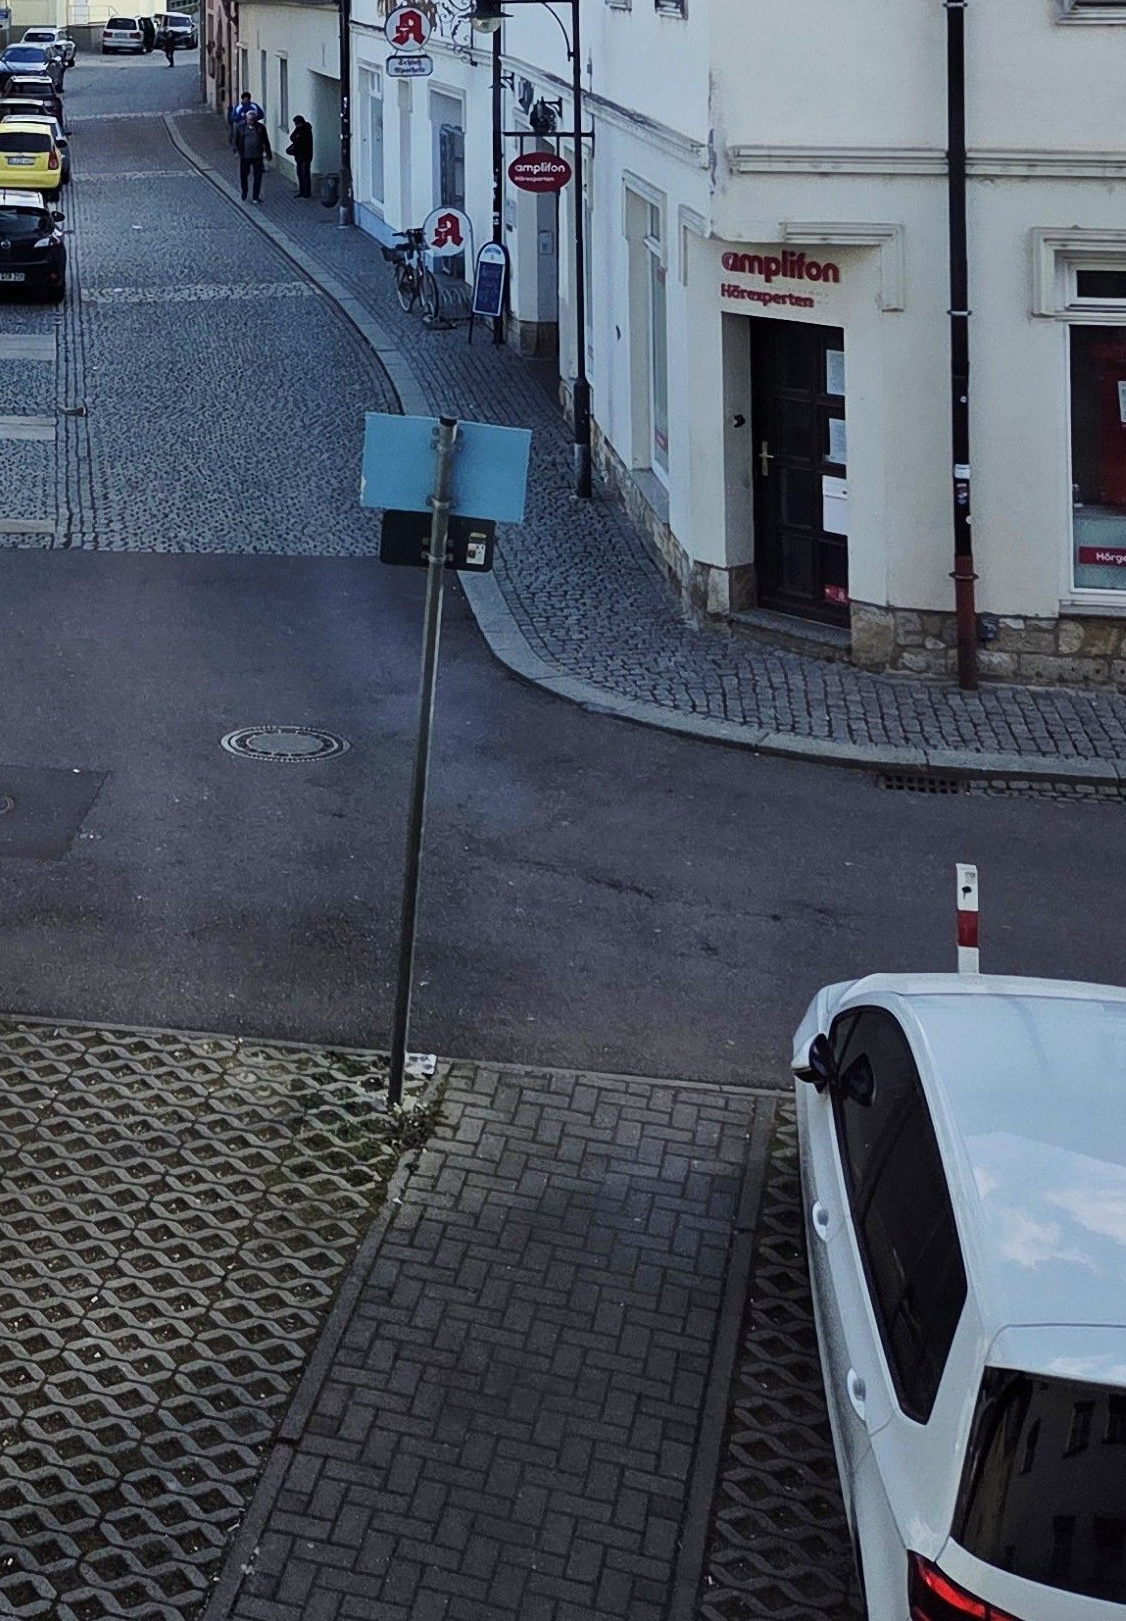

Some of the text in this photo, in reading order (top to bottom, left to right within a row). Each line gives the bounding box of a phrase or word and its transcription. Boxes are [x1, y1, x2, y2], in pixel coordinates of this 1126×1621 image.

[515, 162, 566, 175] amplifon
[721, 250, 840, 283] amplifon
[720, 283, 814, 307] Hörexperten
